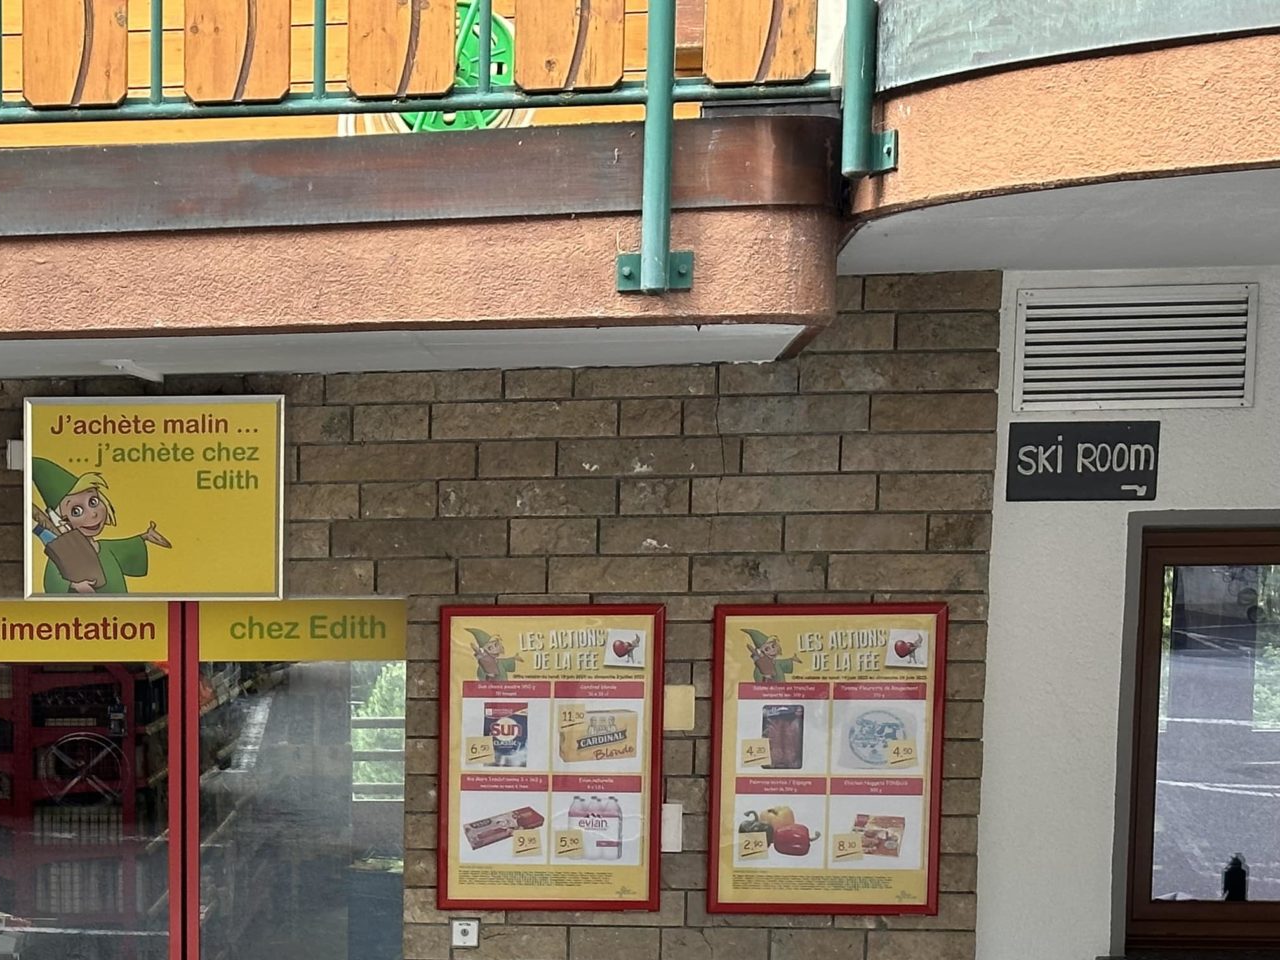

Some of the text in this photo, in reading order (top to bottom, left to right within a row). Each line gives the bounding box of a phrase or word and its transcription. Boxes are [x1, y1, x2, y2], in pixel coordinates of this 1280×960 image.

[50, 415, 156, 435] J'achète
[163, 414, 229, 434] malin
[95, 443, 195, 468] j'achète
[202, 442, 260, 463] chez
[196, 470, 260, 490] Edith
[229, 616, 387, 640] chez Edith
[519, 628, 606, 651] LES ACTIONS
[797, 628, 887, 653] LES ACTIONS
[534, 652, 550, 671] DE
[555, 652, 572, 671] LA
[812, 652, 829, 672] DE
[834, 652, 852, 672] LA
[580, 732, 625, 748] CARDINAL
[578, 818, 608, 828] evian
